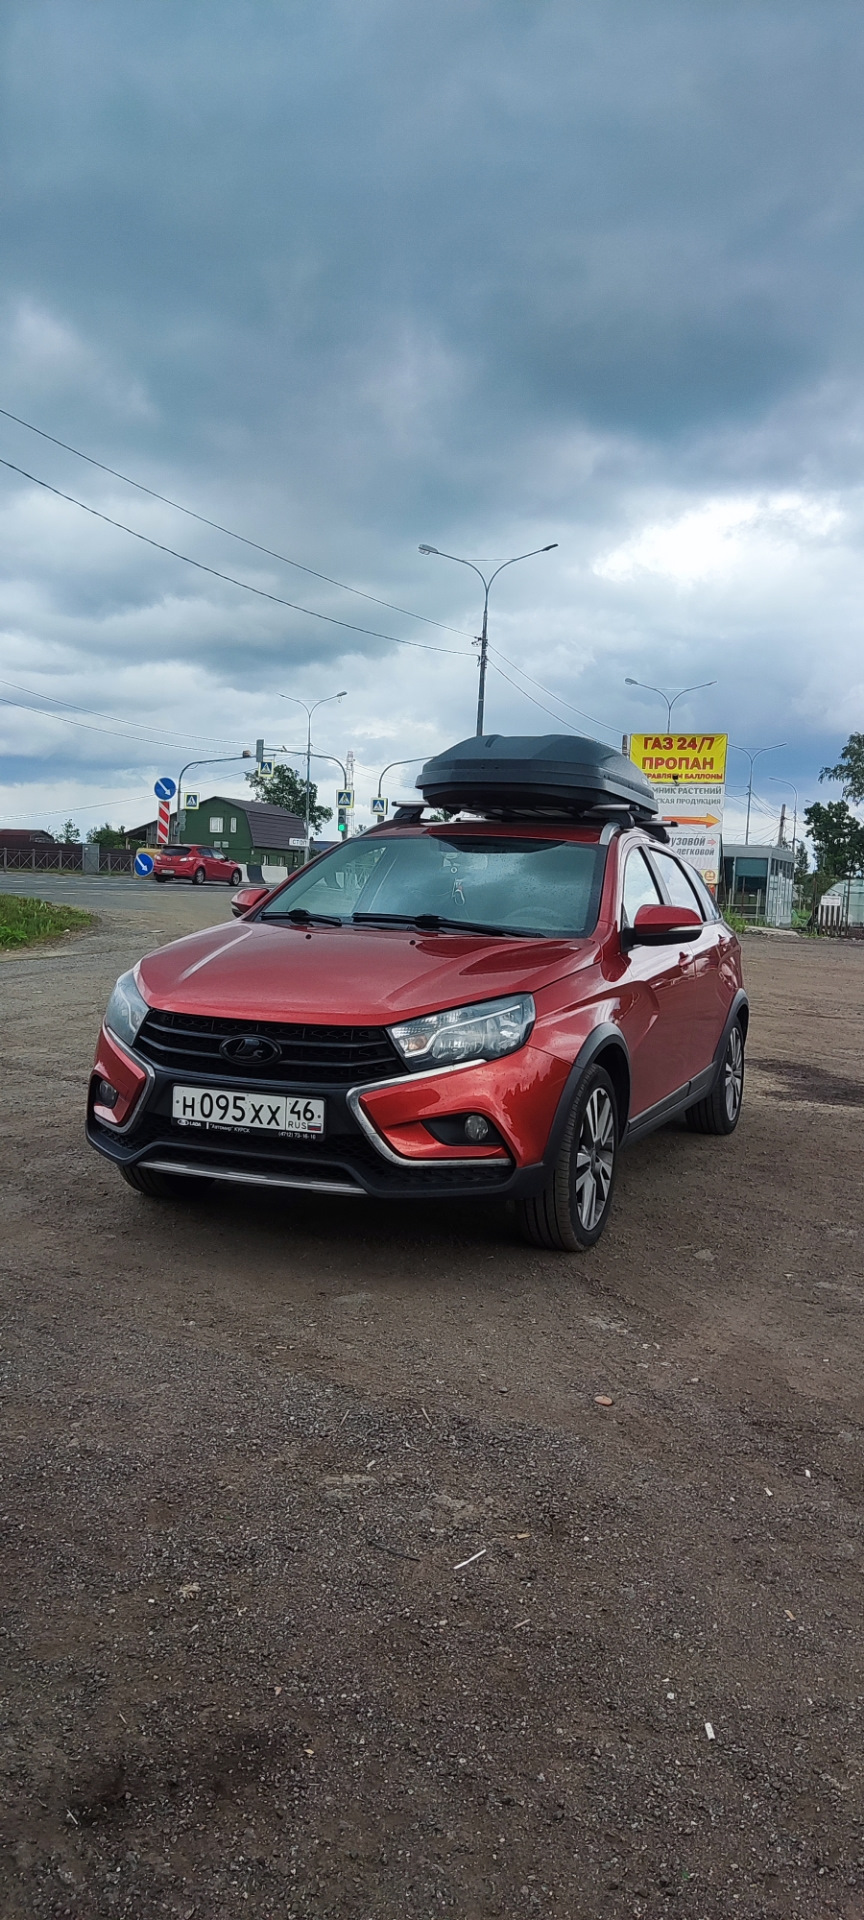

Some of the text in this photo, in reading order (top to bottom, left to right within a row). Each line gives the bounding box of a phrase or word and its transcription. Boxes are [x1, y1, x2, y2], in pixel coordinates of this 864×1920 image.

[643, 736, 715, 754] ГАЗ 24/7
[641, 757, 714, 770] ПРОПАН
[678, 785, 722, 795] РАСТЕНИЙ
[676, 798, 721, 806] ПРОДУКЦИЯ
[289, 1100, 315, 1122] 46
[288, 1121, 307, 1130] RUS
